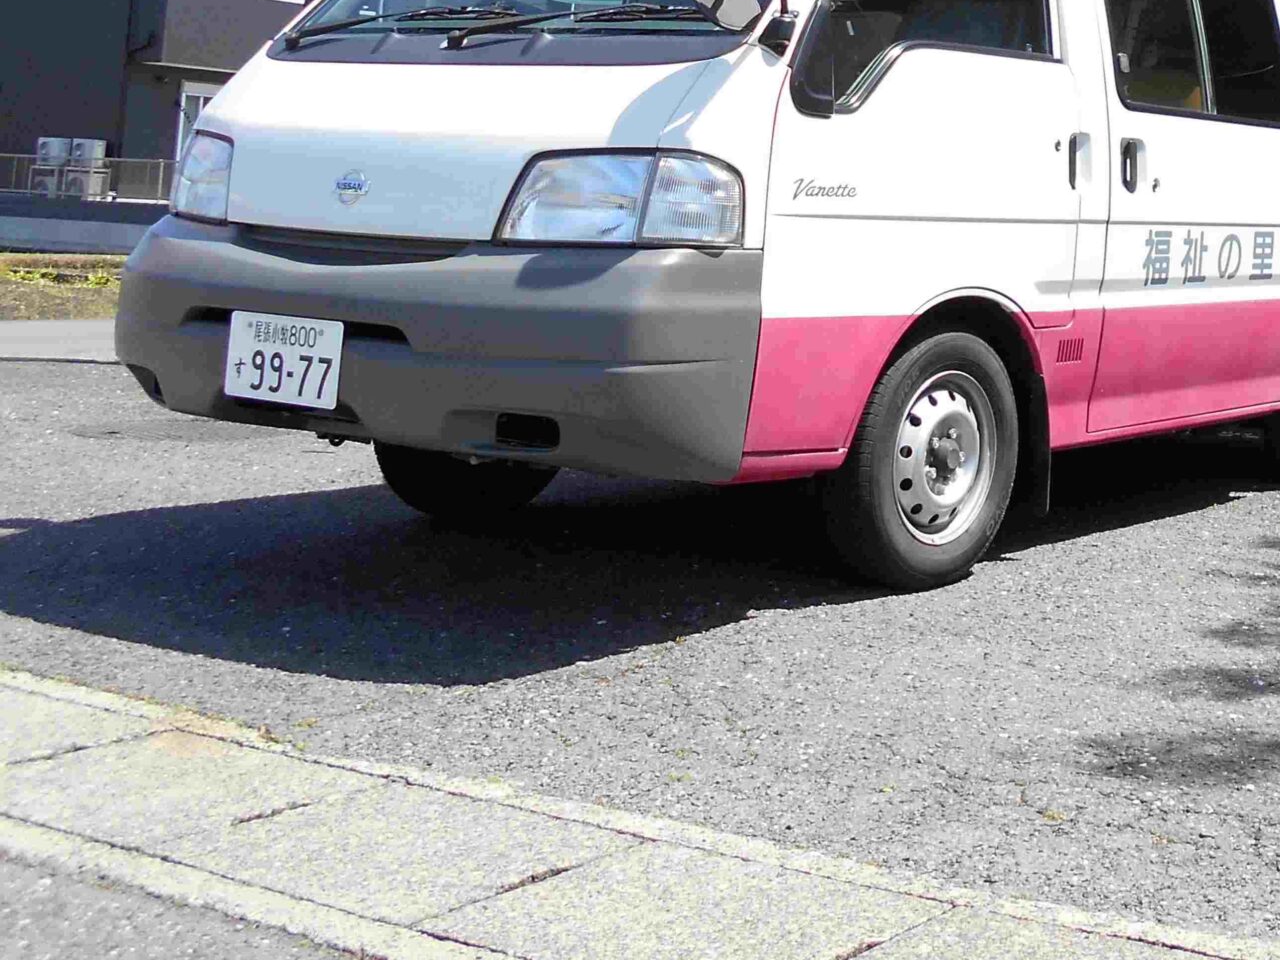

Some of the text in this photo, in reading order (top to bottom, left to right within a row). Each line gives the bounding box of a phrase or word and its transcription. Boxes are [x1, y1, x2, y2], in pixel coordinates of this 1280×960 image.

[336, 181, 363, 191] NISSAN
[792, 178, 858, 200] Vanette
[1141, 230, 1276, 288] 福祉の里
[250, 349, 333, 399] 99-77
